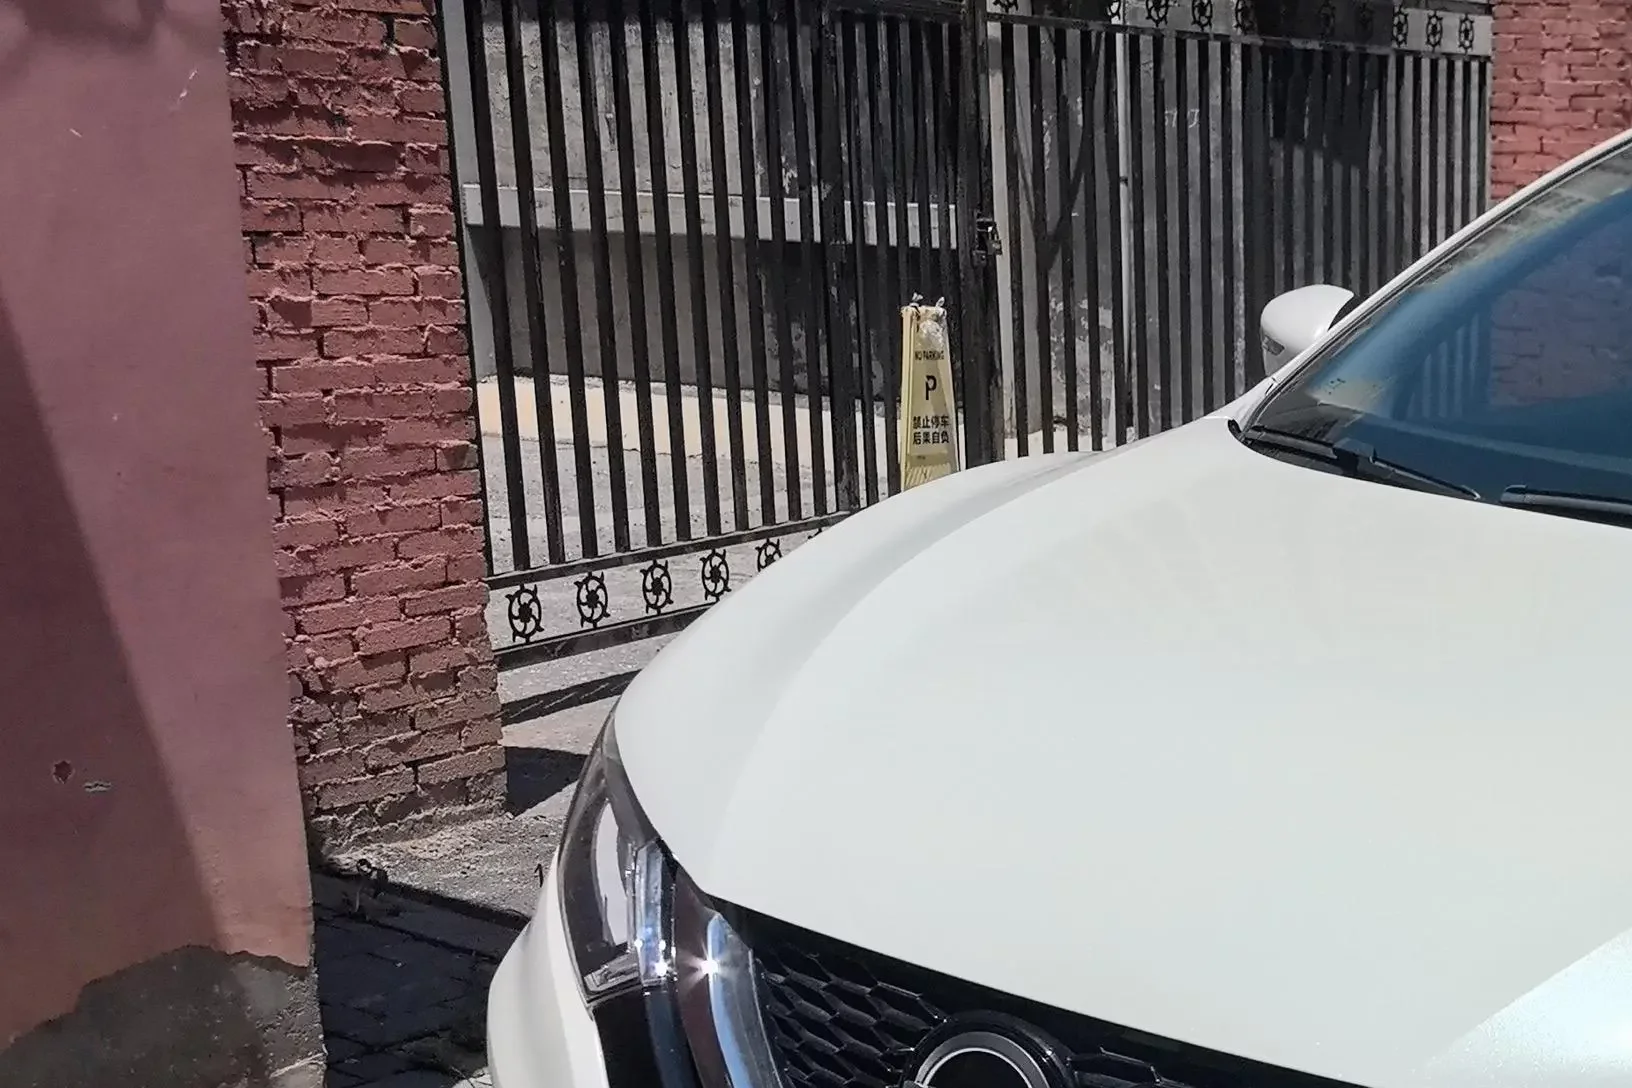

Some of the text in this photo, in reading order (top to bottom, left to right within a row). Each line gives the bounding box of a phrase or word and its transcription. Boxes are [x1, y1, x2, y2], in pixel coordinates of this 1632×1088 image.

[925, 375, 937, 401] P
[912, 415, 949, 429] 禁止停车
[912, 430, 949, 445] 后果自负
